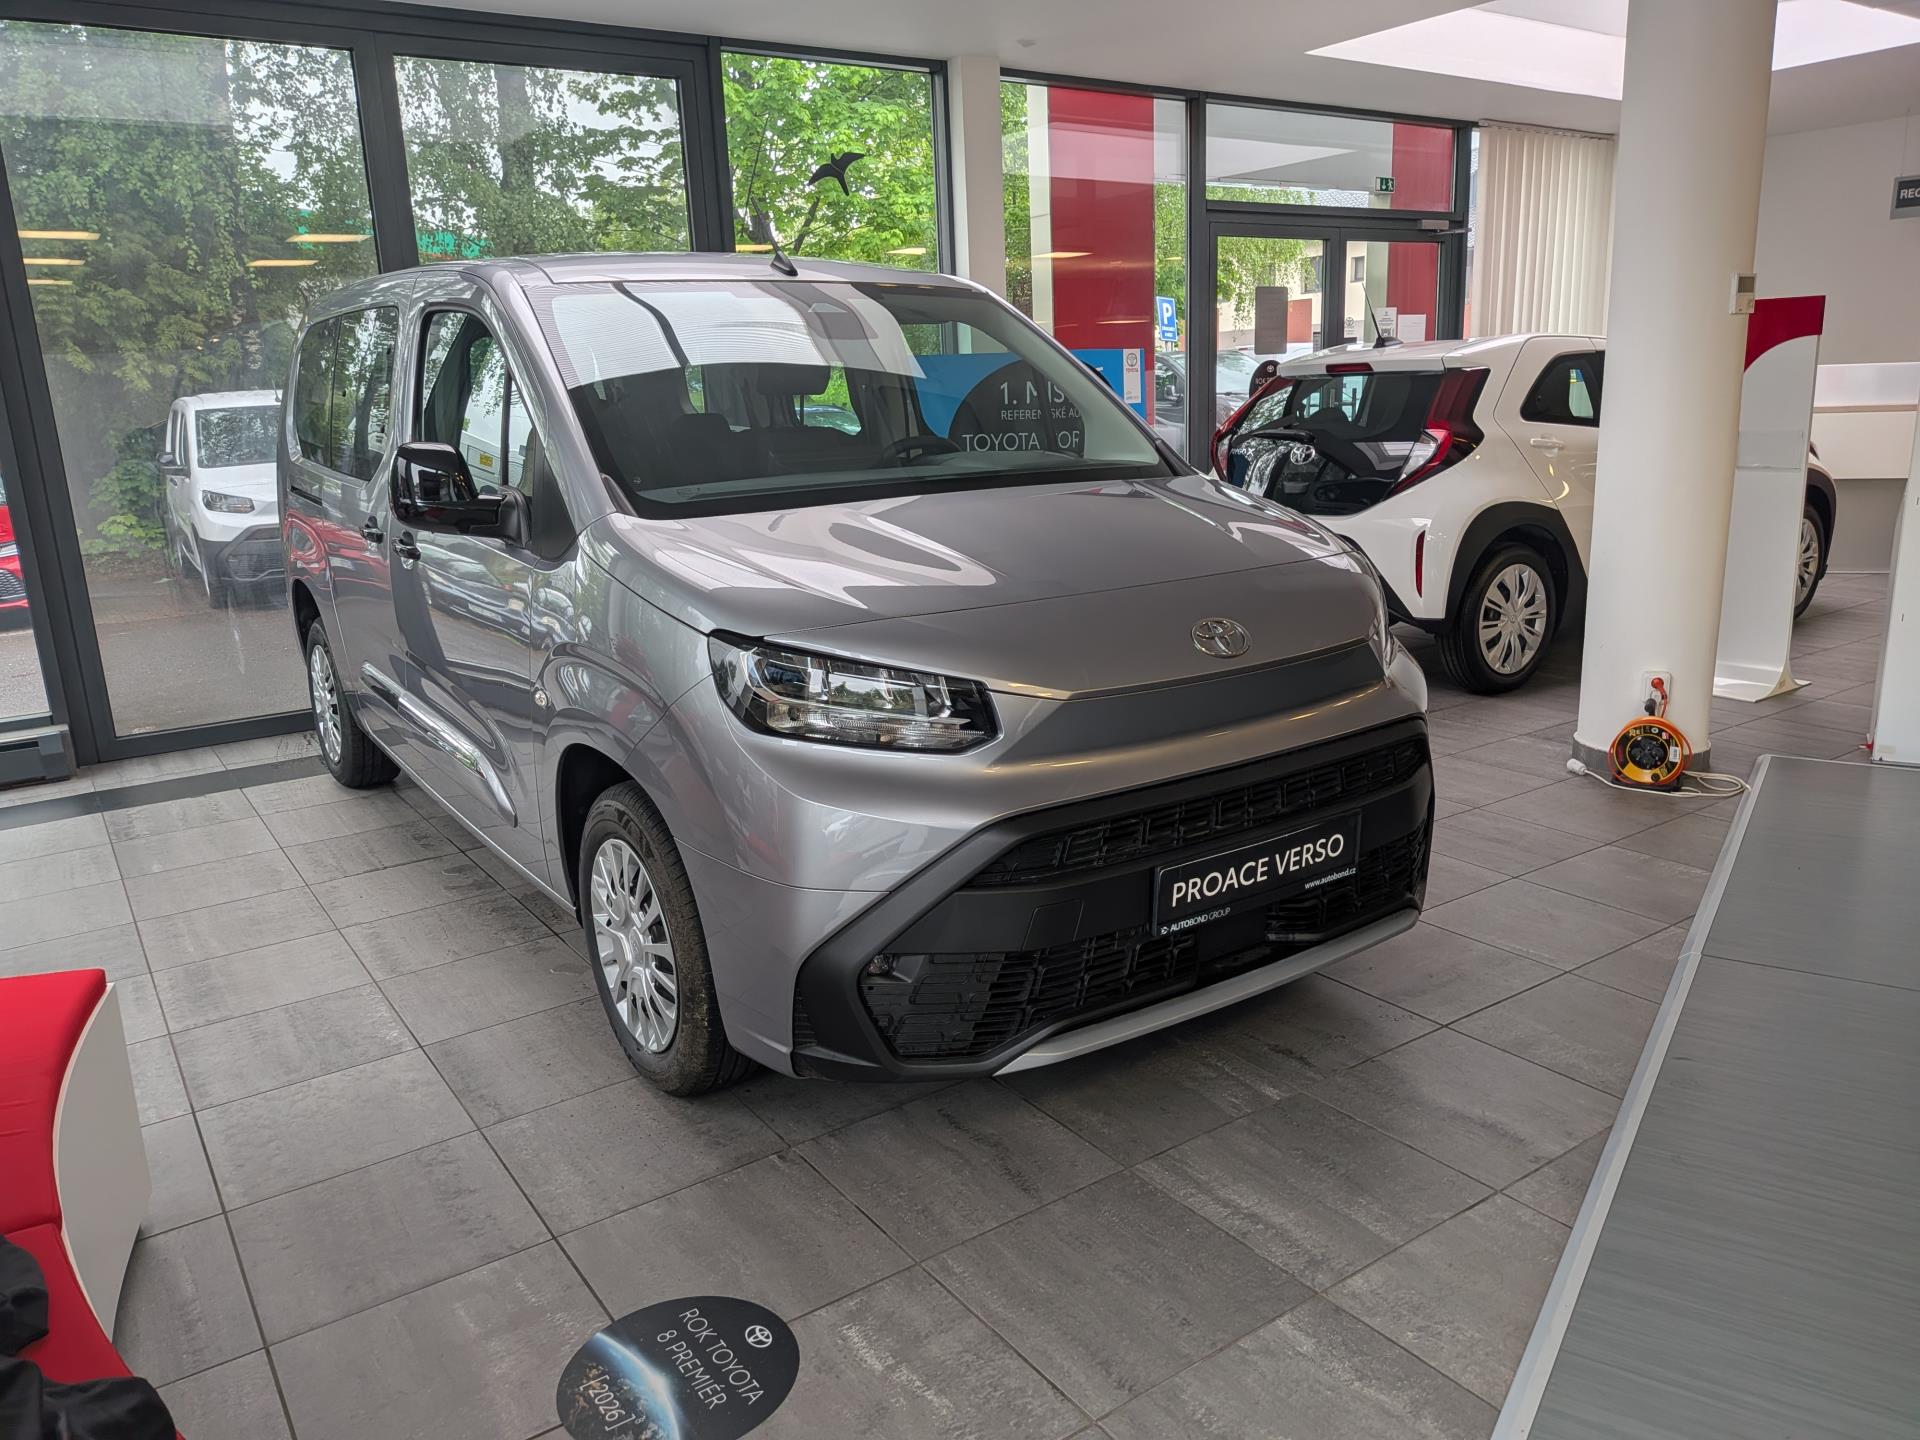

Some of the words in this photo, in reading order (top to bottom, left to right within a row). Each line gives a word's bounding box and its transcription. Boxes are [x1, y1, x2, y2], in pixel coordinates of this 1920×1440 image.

[1900, 187, 1920, 200] REC
[1162, 302, 1172, 325] P
[1000, 381, 1017, 405] 1.
[961, 432, 1040, 452] TOYOTA
[1171, 856, 1269, 908] PROACE
[1275, 833, 1345, 876] VERSO
[1304, 867, 1357, 890] www.autobond.cz
[1169, 914, 1208, 933] AUTOBOND
[1208, 906, 1231, 920] GROUP
[656, 1329, 678, 1343] 8
[678, 1307, 718, 1344] ROK
[705, 1338, 765, 1406] TOYOTA
[664, 1340, 727, 1410] PREMIÉR
